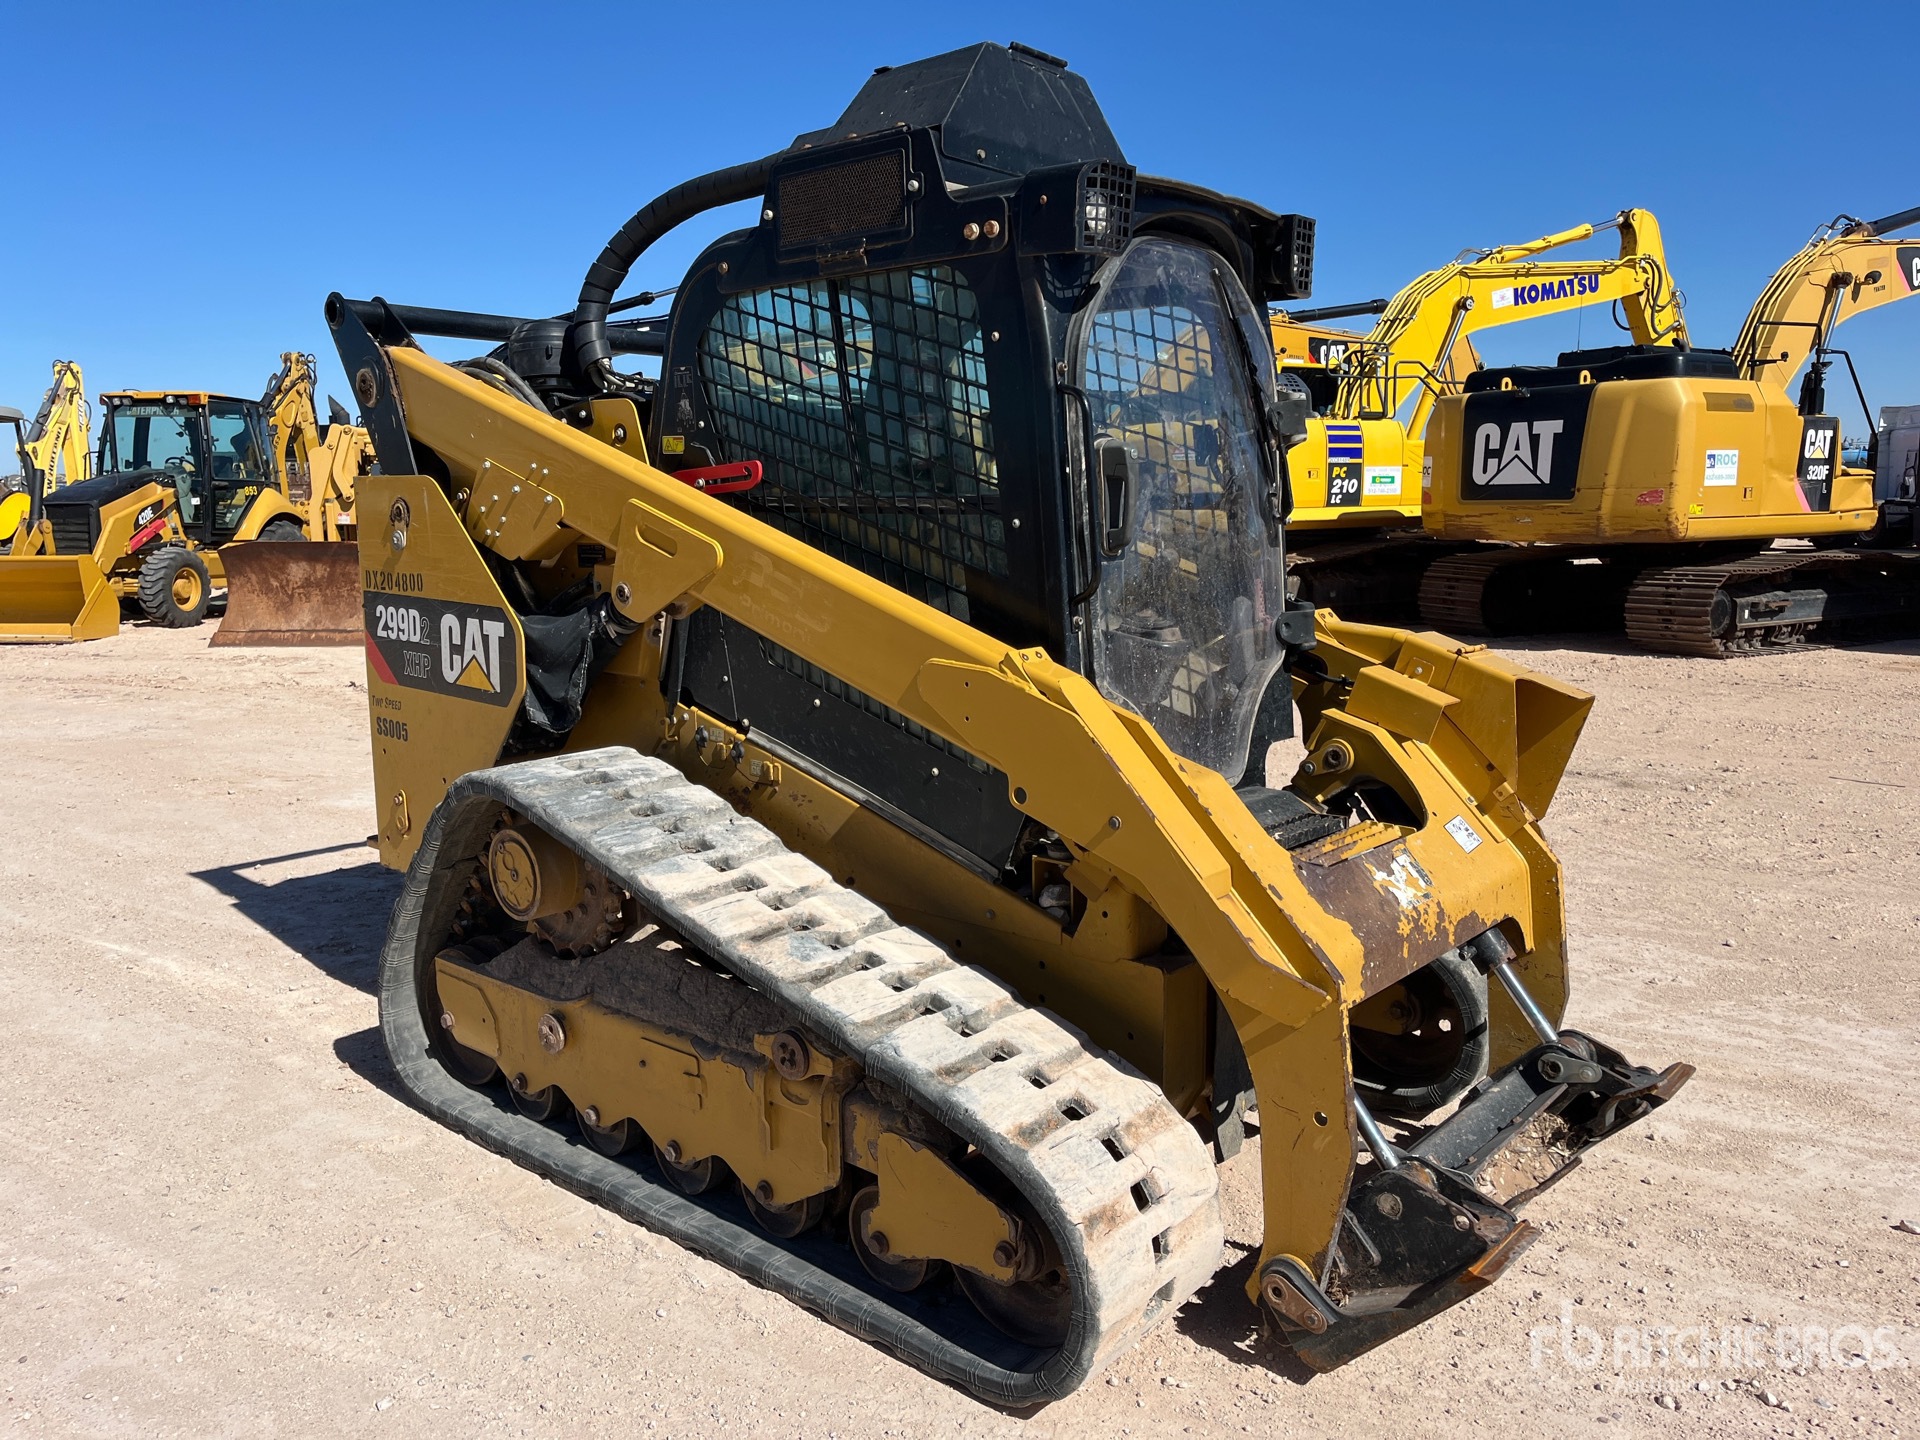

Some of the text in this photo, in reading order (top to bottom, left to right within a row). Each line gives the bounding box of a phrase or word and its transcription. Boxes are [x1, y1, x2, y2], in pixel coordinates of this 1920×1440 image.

[1513, 272, 1599, 307] KOMATSU
[1320, 344, 1346, 365] CAT
[1472, 419, 1564, 485] CAT
[1804, 429, 1833, 459] CAT
[1717, 454, 1737, 465] ROC
[1332, 466, 1348, 478] PC
[1806, 465, 1829, 480] 320F
[244, 486, 257, 496] 853
[1331, 479, 1358, 493] 210
[1822, 482, 1827, 493] L
[1330, 494, 1342, 503] LC
[138, 506, 155, 525] 420E
[365, 569, 423, 592] DX204800
[375, 604, 505, 693] 299D2 CAT
[403, 650, 431, 679] XHP
[376, 716, 409, 742] SS005
